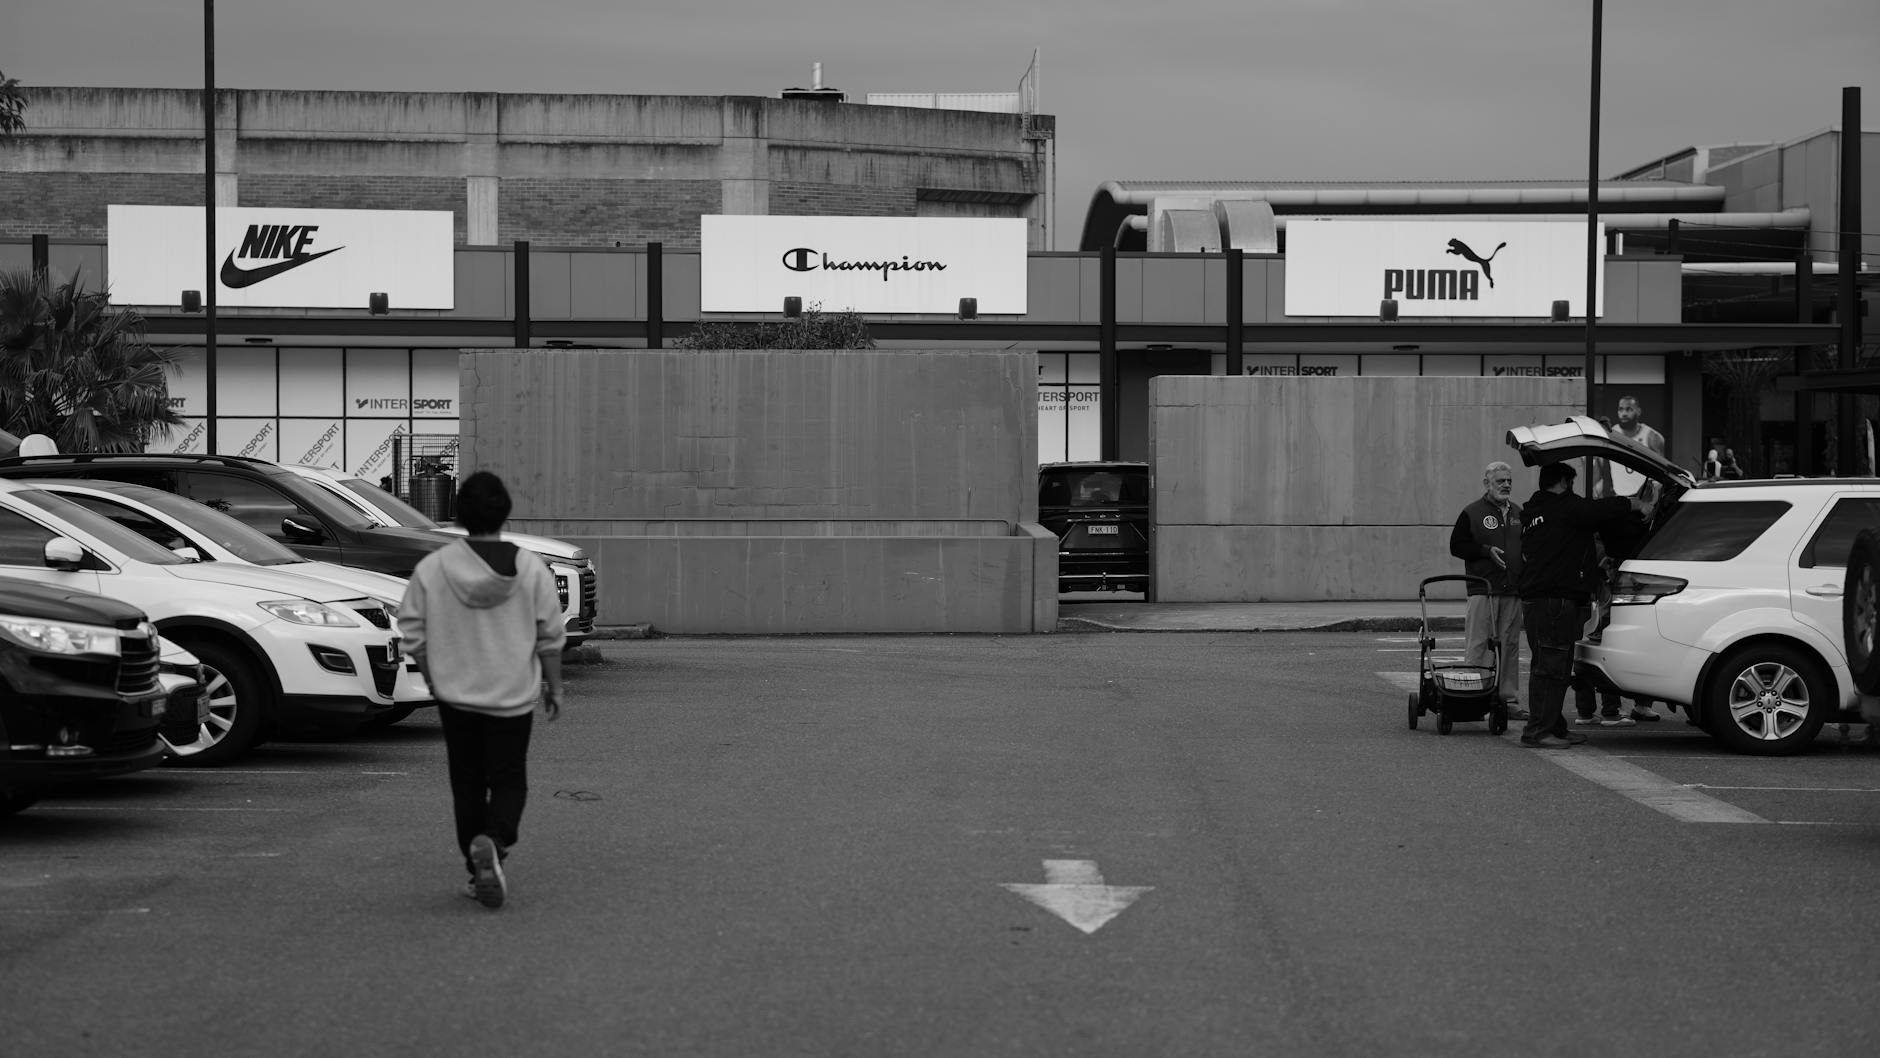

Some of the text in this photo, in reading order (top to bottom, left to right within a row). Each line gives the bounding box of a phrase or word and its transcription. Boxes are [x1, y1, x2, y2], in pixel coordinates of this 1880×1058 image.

[237, 224, 320, 259] NIKE
[782, 247, 948, 282] Champion
[1384, 268, 1479, 300] PUMA
[236, 422, 274, 458] RSPORT
